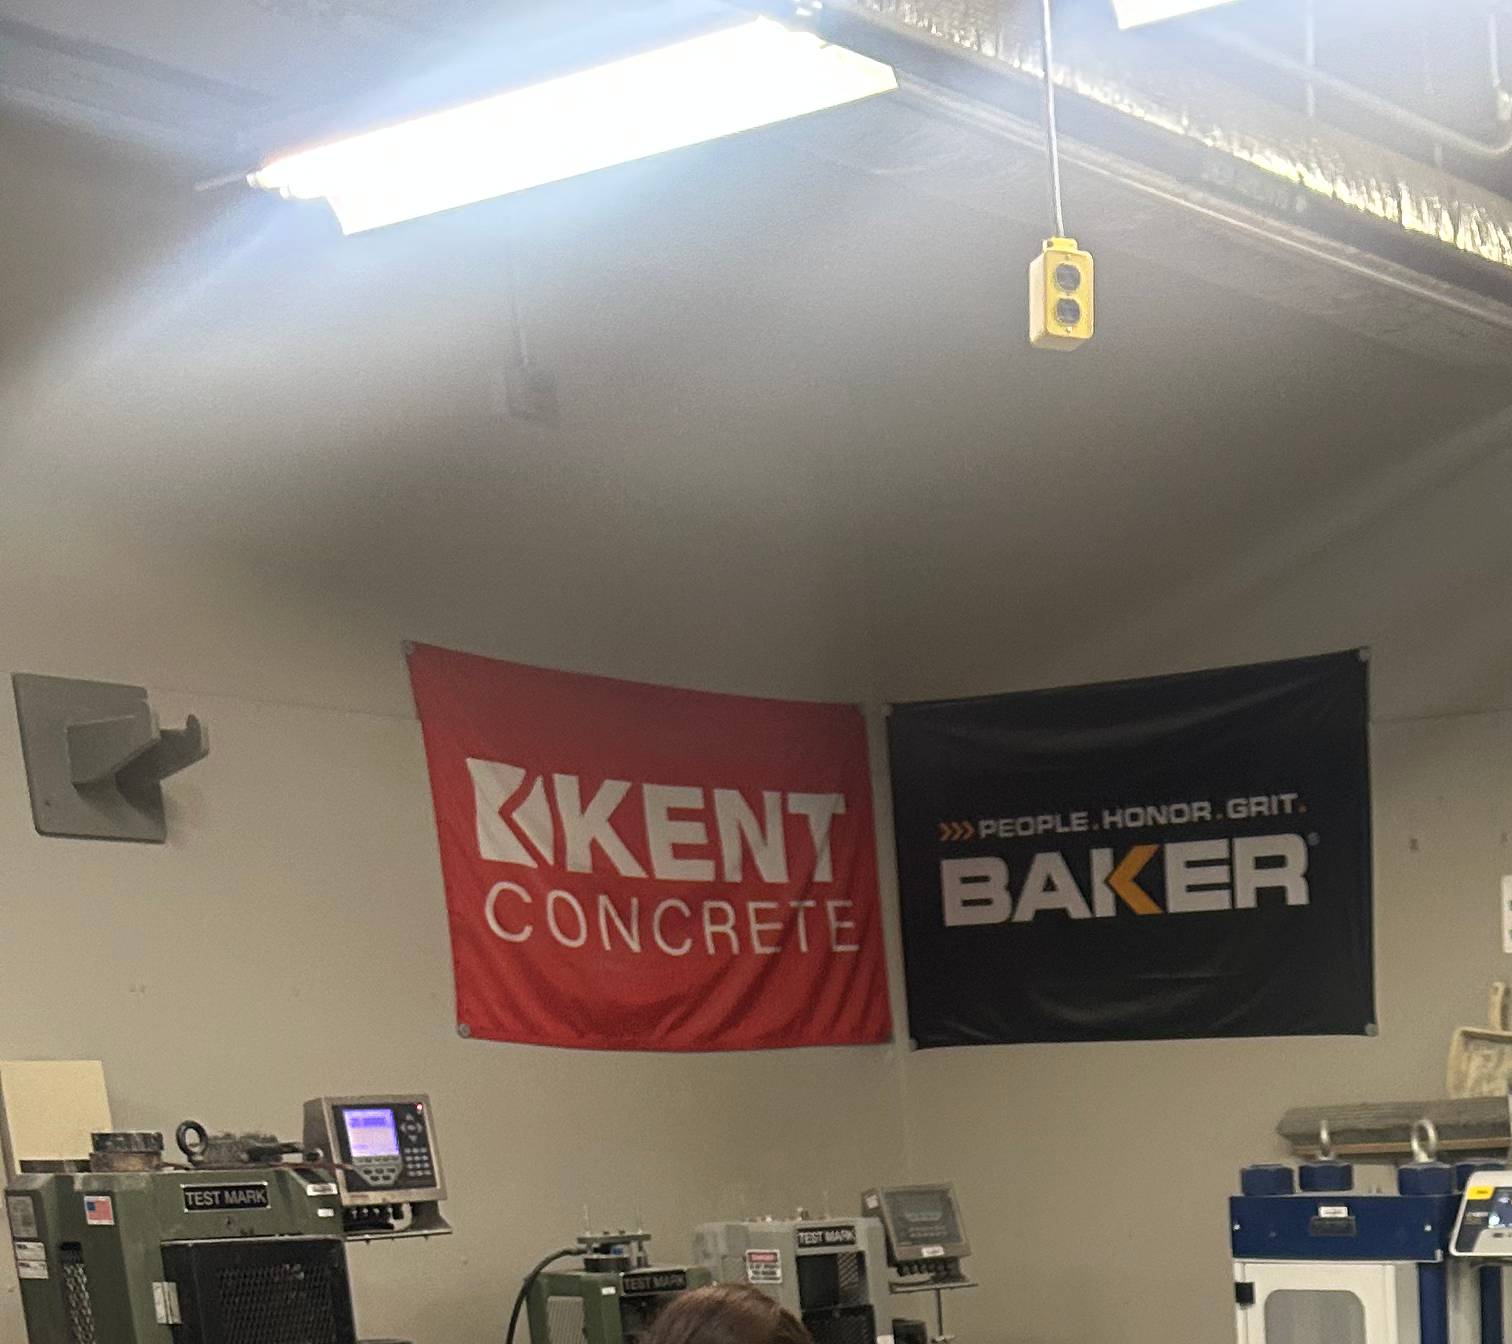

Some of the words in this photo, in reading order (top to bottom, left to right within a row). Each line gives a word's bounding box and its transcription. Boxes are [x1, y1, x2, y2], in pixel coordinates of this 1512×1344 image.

[553, 773, 846, 884] KENT
[940, 833, 1312, 926] BAKER
[483, 881, 863, 954] CONCRETE
[186, 1191, 221, 1206] TEST
[224, 1189, 266, 1205] MARK
[798, 1229, 825, 1245] TEST
[624, 1277, 654, 1291] TEST
